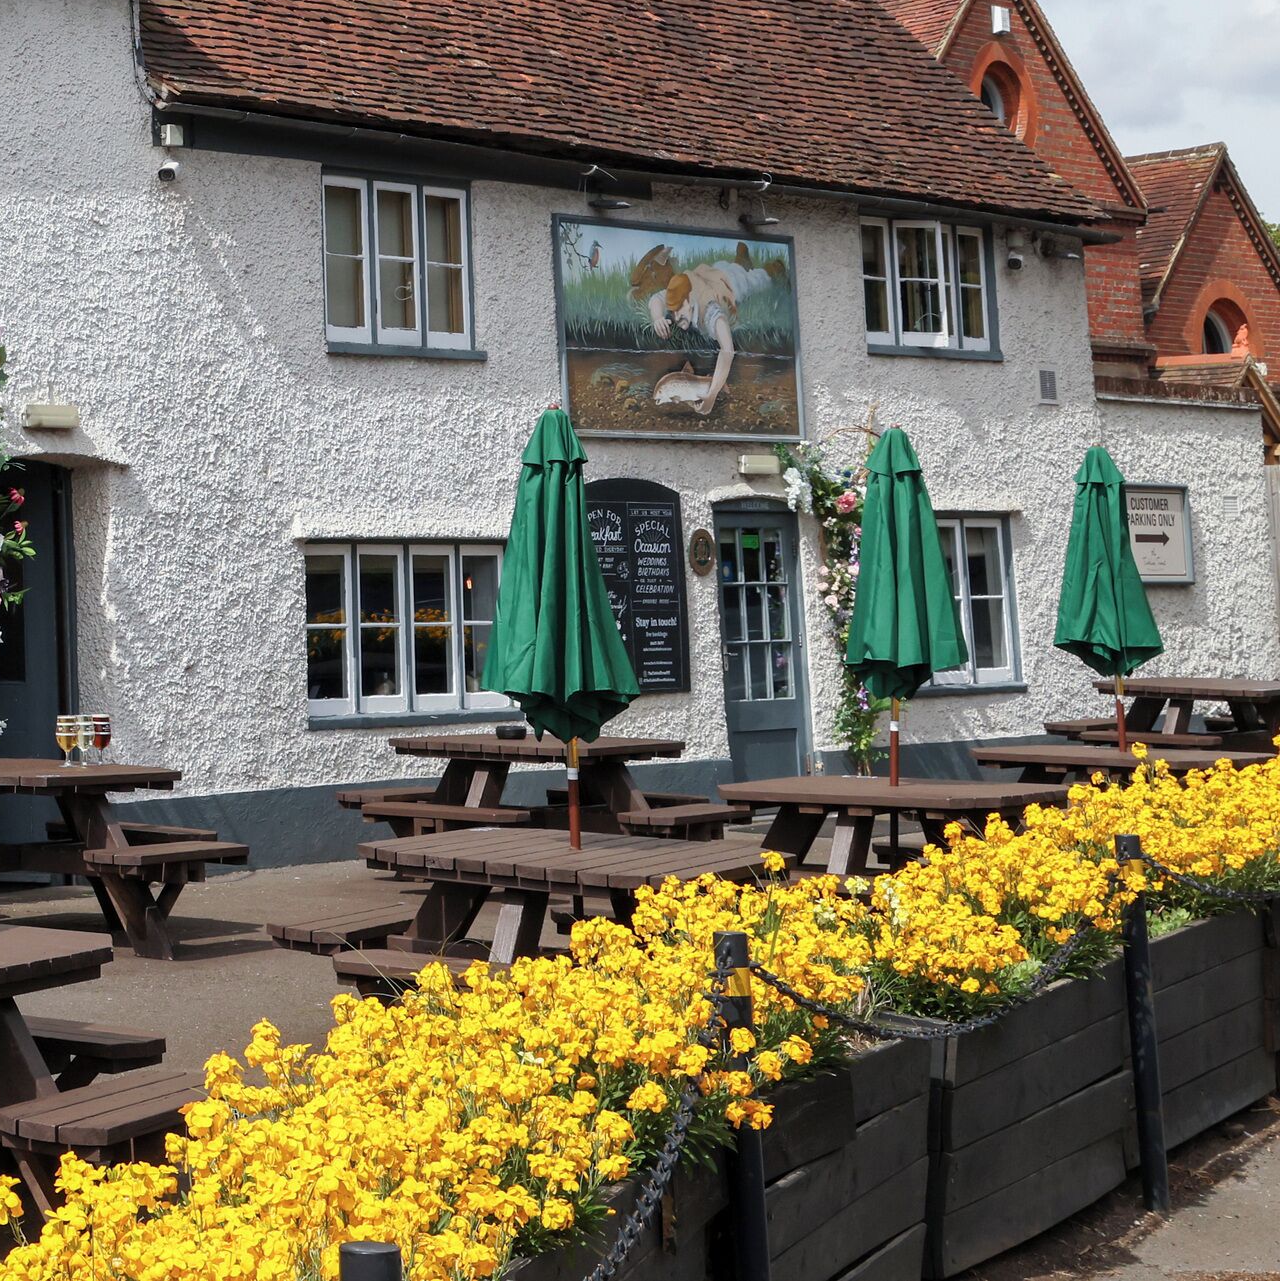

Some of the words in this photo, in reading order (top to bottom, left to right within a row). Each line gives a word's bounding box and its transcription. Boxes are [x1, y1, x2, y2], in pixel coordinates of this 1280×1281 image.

[1131, 497, 1169, 510] CUSTOMER
[587, 509, 603, 522] PEN
[606, 510, 621, 526] FOR
[1158, 513, 1175, 526] ONLY
[635, 520, 670, 538] SPECIAL
[634, 538, 671, 553] Occasion
[638, 567, 670, 576] BIRTHDAYS
[636, 585, 674, 593] CELEBRATION
[635, 617, 649, 629] Stay
[650, 617, 658, 627] in
[658, 617, 677, 626] touch!
